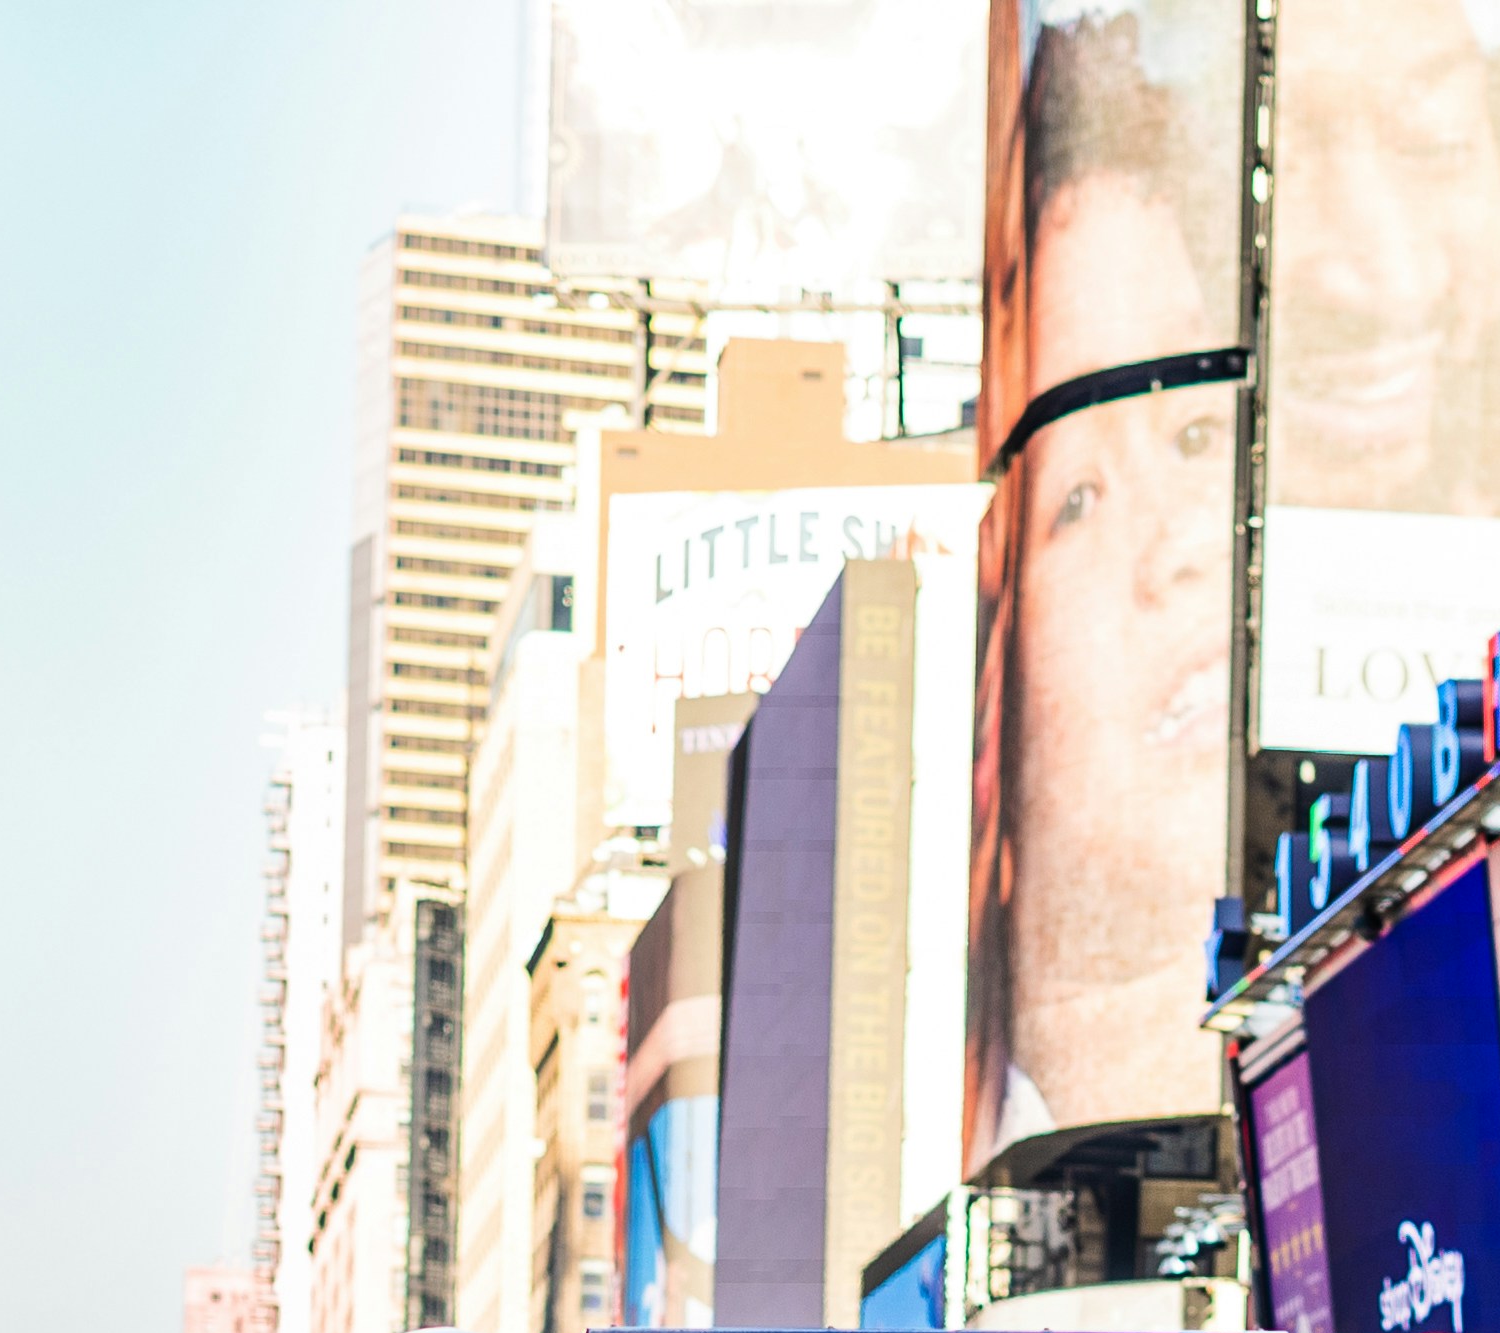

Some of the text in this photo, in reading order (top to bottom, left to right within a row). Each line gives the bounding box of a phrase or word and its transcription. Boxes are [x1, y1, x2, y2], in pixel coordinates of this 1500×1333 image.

[655, 511, 898, 605] LITTLE SH
[855, 604, 901, 659] BE
[852, 680, 899, 902] FEATURED
[850, 911, 891, 975] ON
[845, 983, 888, 1072] THE
[843, 1080, 886, 1154] BIG
